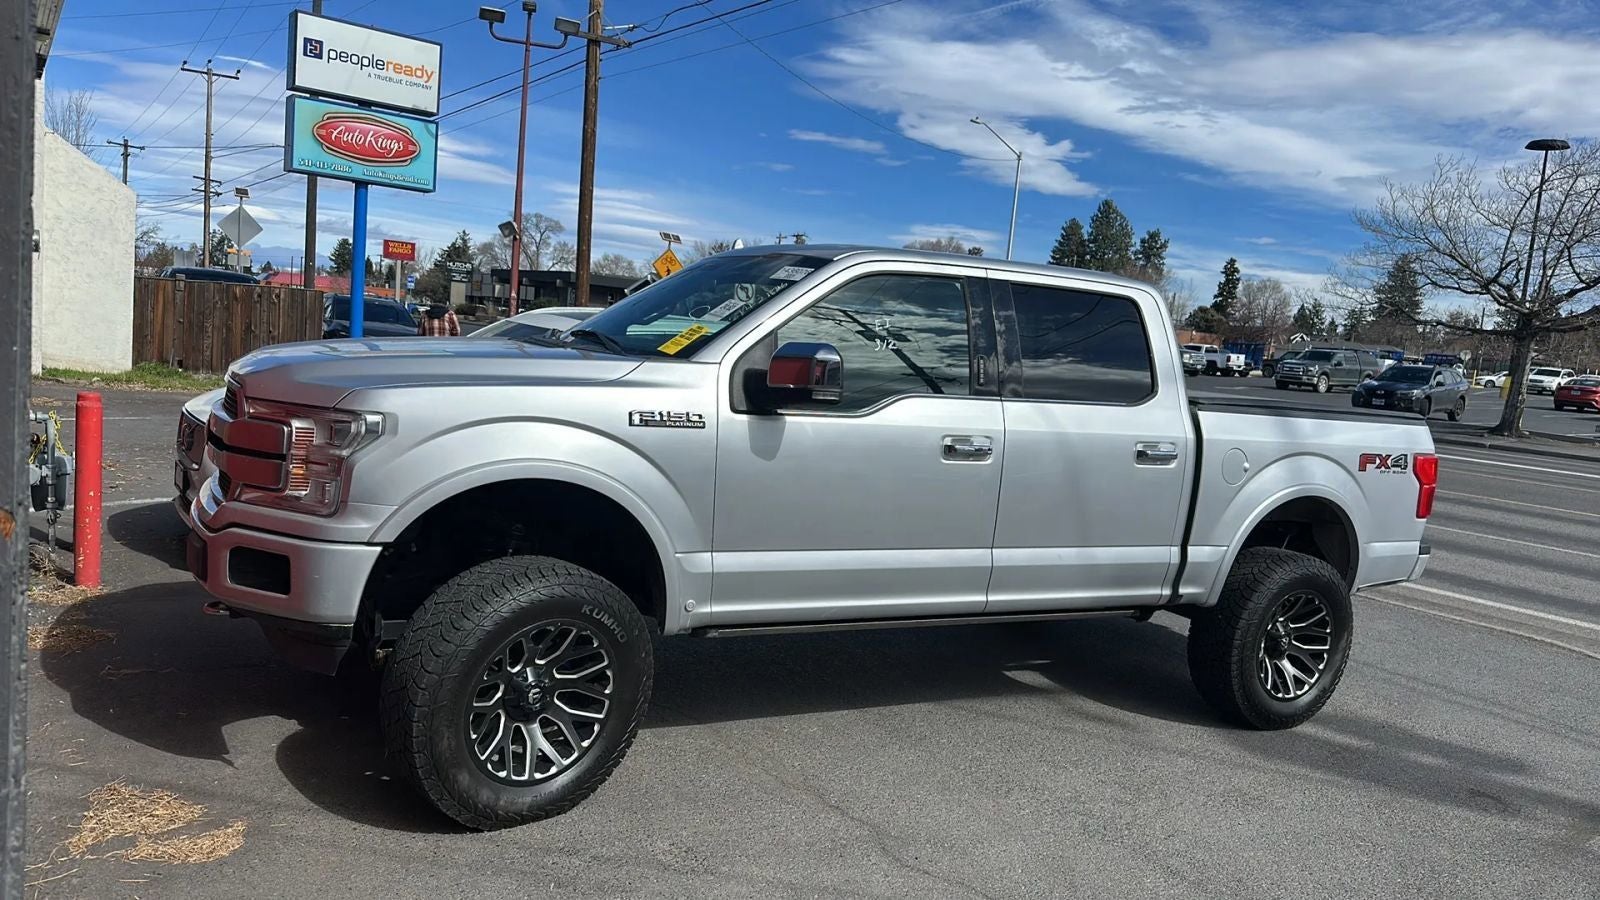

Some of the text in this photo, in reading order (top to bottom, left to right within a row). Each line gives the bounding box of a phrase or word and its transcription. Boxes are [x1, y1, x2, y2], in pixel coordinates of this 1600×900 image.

[327, 48, 434, 83] peopleready
[373, 73, 404, 85] TRUEBLUE
[405, 80, 432, 90] COMPANY
[388, 241, 411, 249] WELLS
[389, 247, 411, 255] FARGO
[666, 420, 704, 428] PLATINUM
[1358, 453, 1408, 472] FX4
[581, 604, 628, 642] KUMHO
